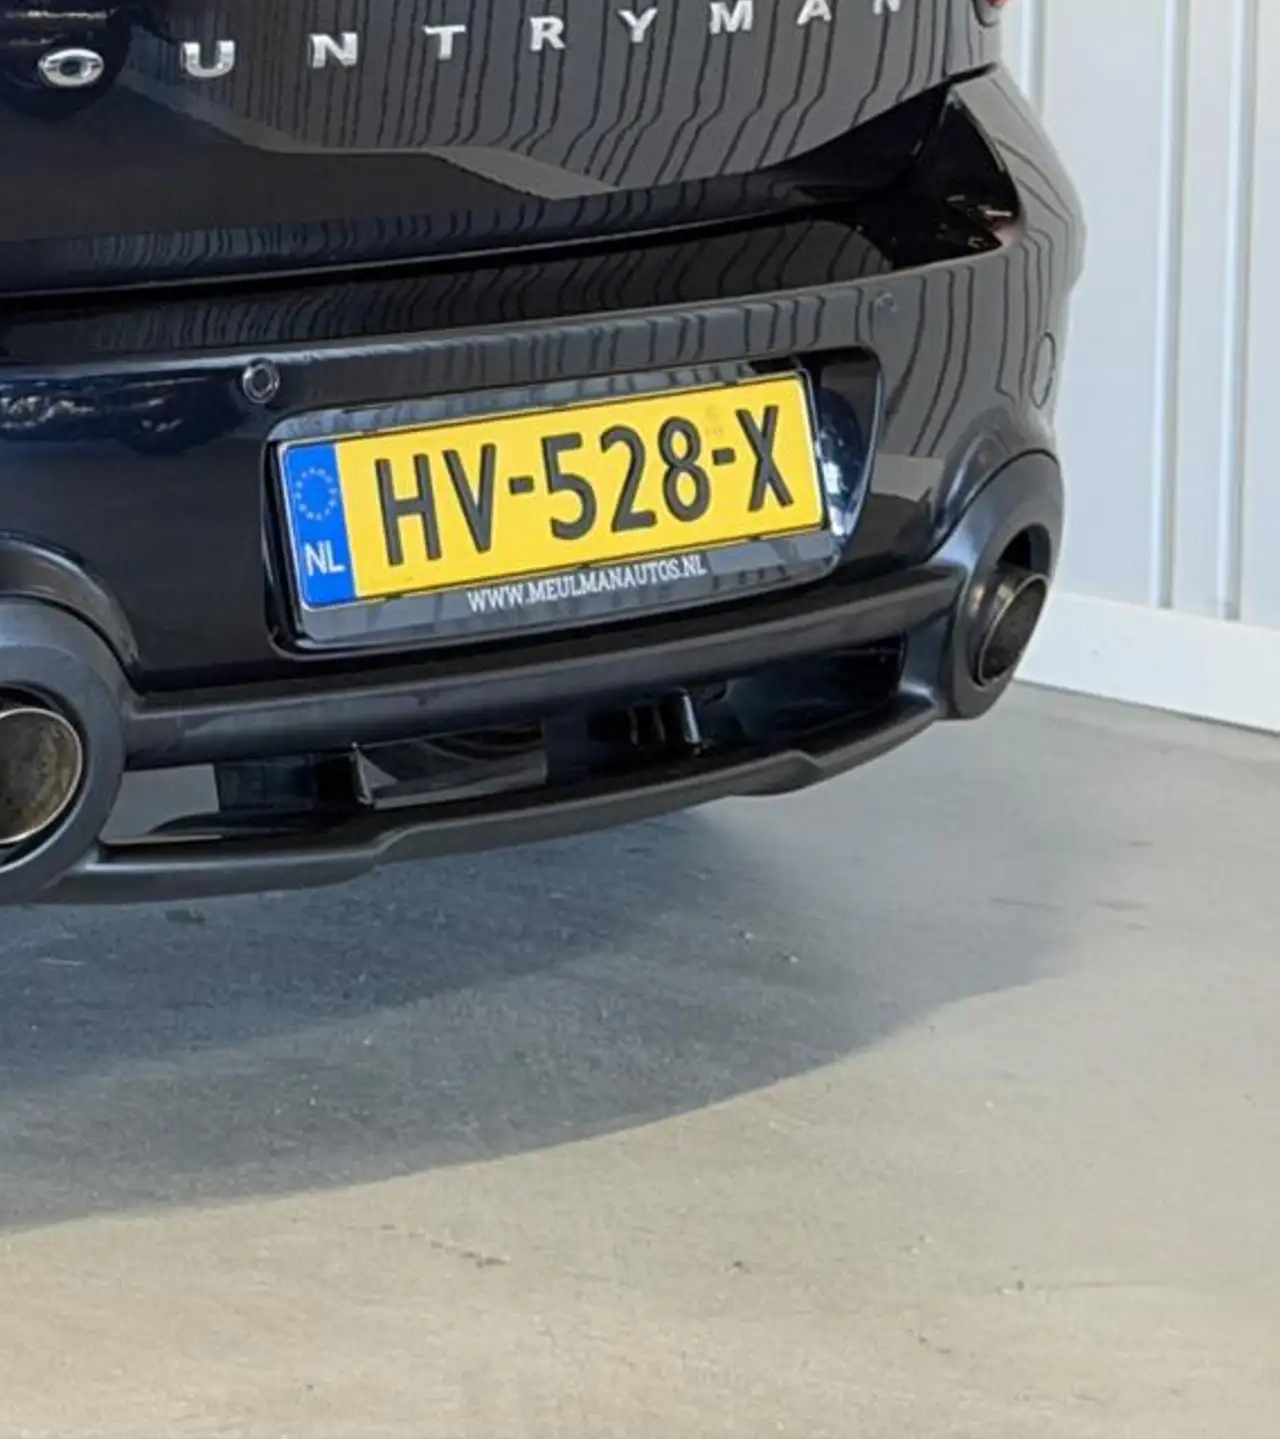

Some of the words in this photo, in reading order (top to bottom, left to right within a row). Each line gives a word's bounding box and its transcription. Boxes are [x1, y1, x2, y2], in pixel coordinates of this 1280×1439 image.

[374, 403, 794, 567] HV-528-X
[304, 539, 346, 577] NL
[466, 553, 708, 614] WWW.MEULMANAUTOS.NL
